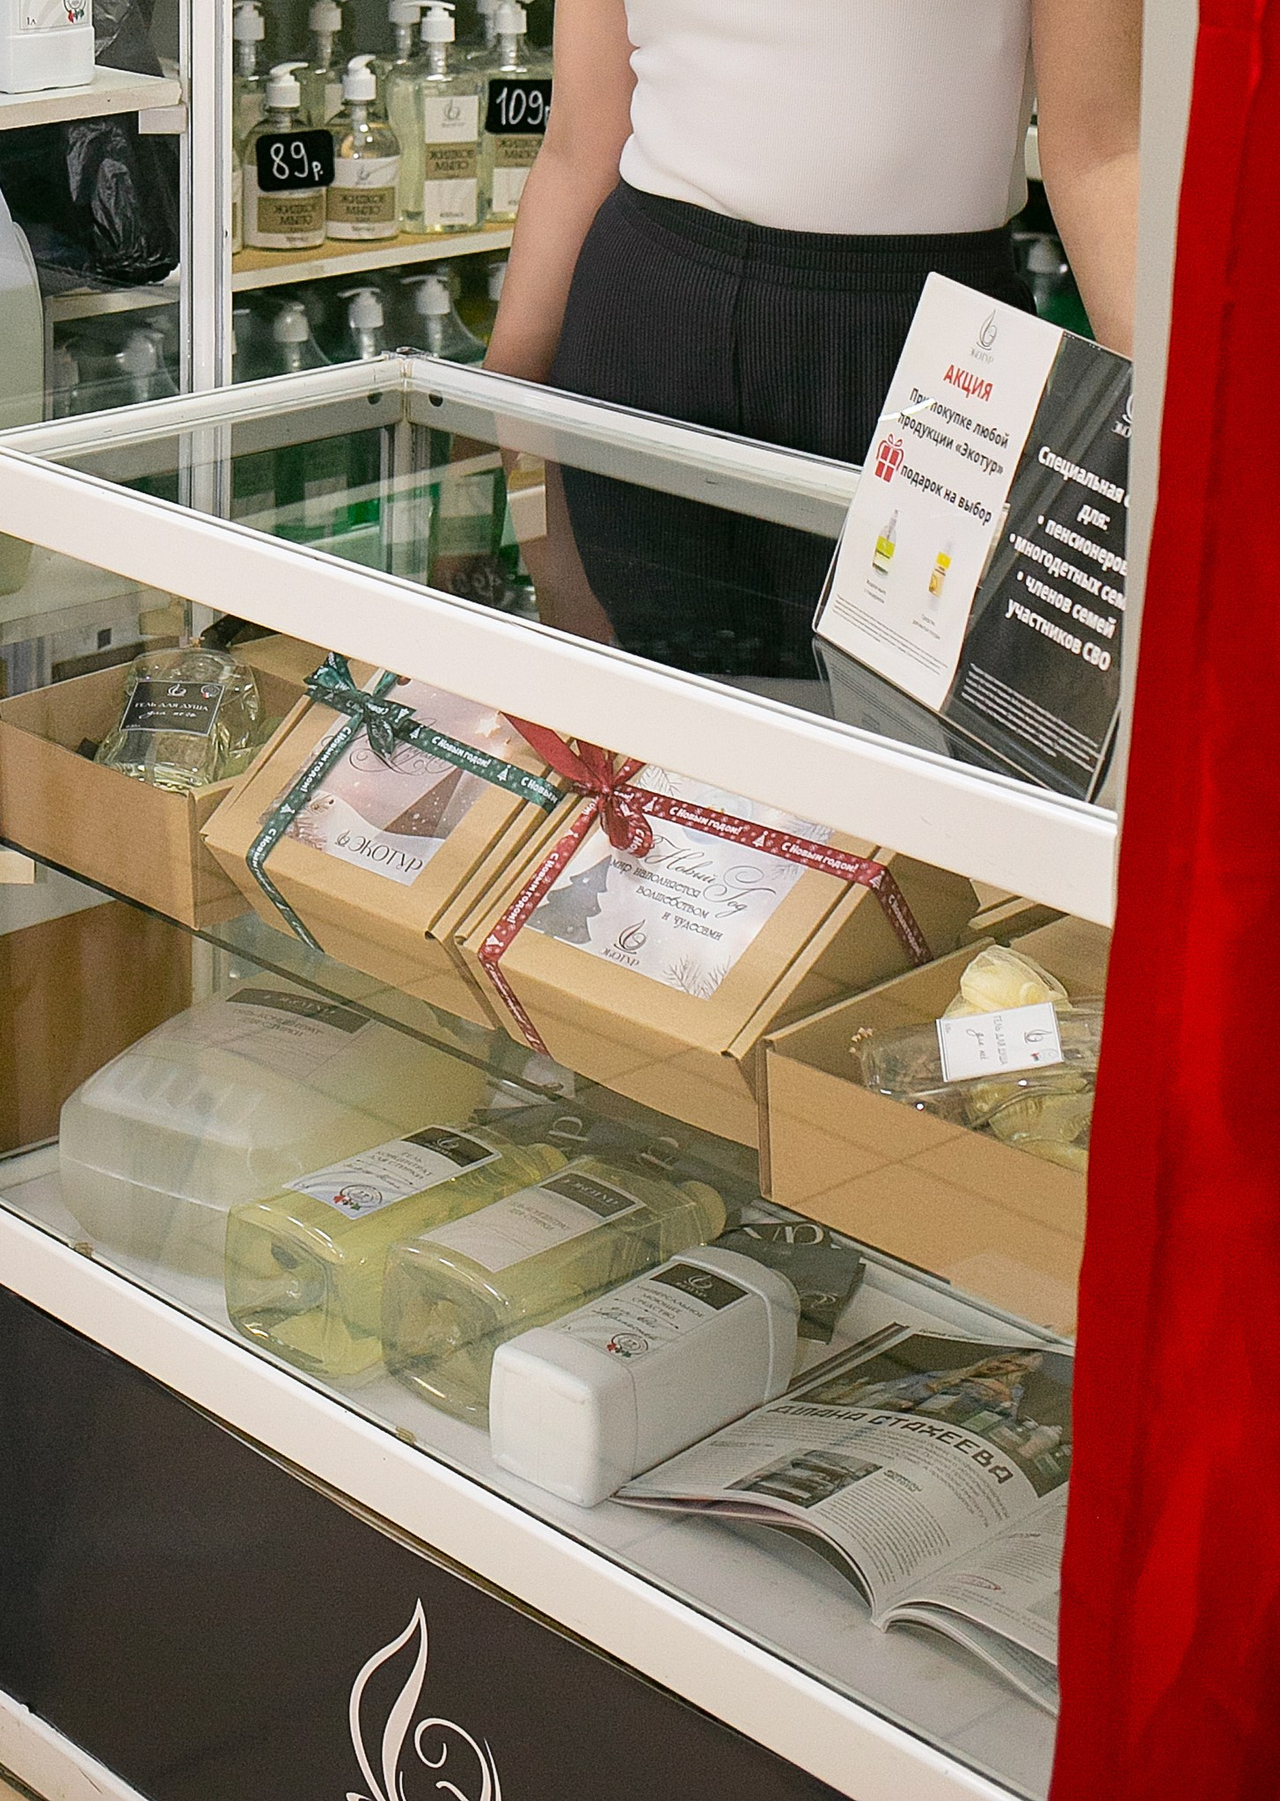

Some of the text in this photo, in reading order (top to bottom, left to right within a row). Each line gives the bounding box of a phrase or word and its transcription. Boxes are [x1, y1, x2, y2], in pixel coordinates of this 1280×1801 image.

[943, 364, 994, 402] АКЦИЯ
[897, 411, 1004, 475] продукции «Экотур»
[930, 400, 973, 431] покупке
[972, 421, 1010, 449] любой
[900, 463, 992, 526] подарок на выбор
[1037, 445, 1125, 504] Специальная
[1076, 503, 1111, 531] для:
[1014, 536, 1099, 596] многодетных
[1004, 598, 1112, 672] участников СВО
[1025, 574, 1117, 639] членов семей
[180, 703, 209, 712] ДУША
[347, 835, 424, 873] ЭКОТУР
[610, 858, 633, 874] мир
[644, 834, 777, 918] Новый Год
[635, 885, 710, 919] волшебством
[868, 1414, 1015, 1485] СТАХЕЕВА
